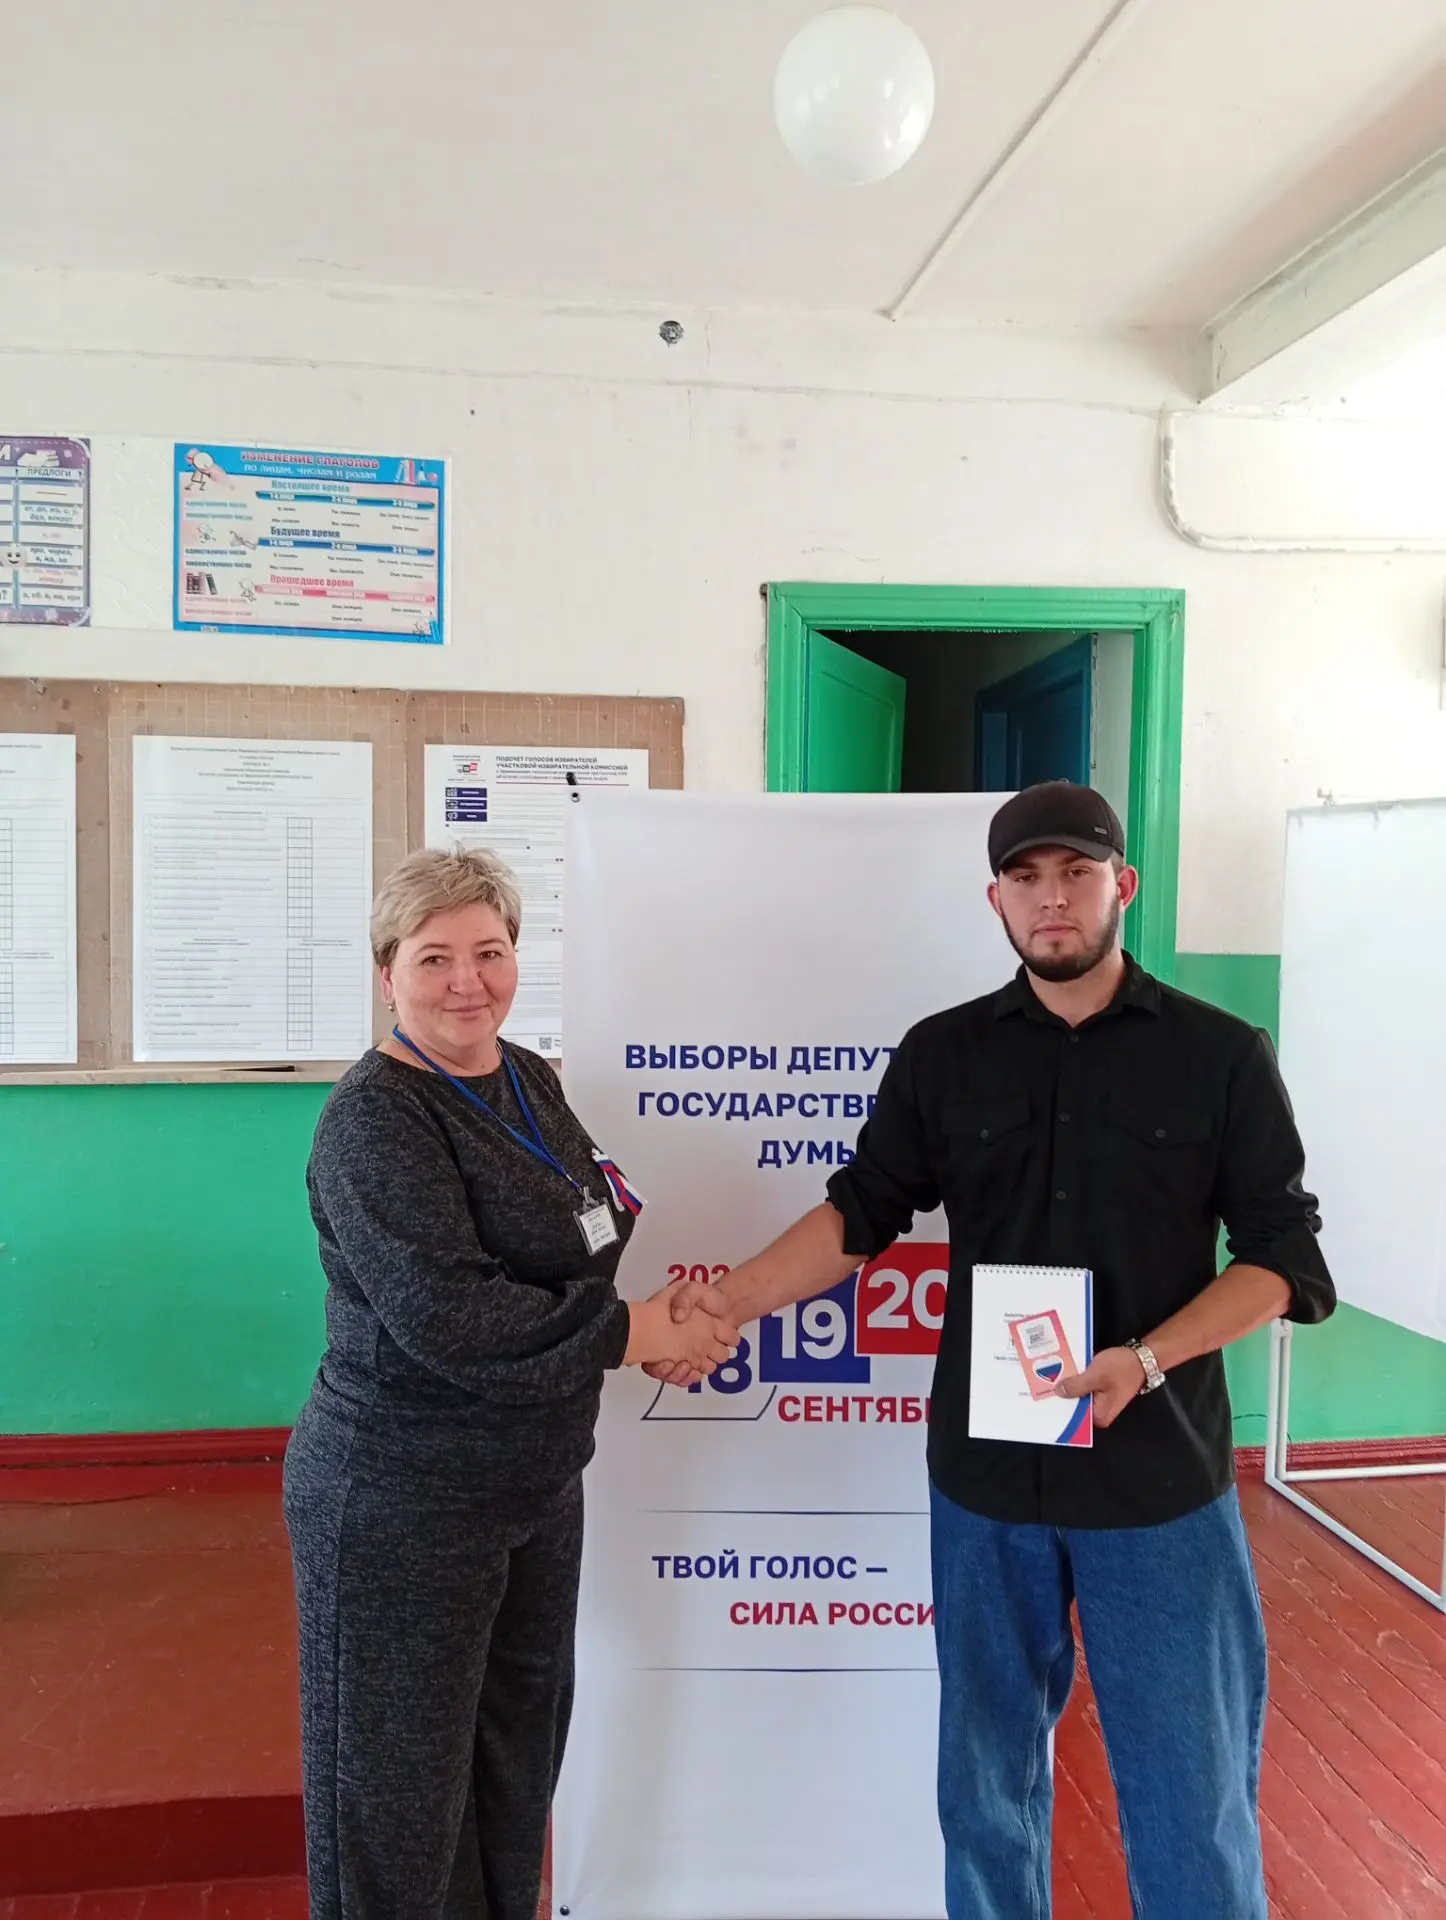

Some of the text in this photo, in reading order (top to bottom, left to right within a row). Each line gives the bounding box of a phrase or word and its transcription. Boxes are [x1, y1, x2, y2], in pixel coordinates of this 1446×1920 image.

[241, 452, 379, 469] ИЗМЕНЕНИЕ ГЛАГОЛОВ
[27, 468, 71, 477] ПРЕДЛОГИ
[271, 480, 320, 490] Настоящее
[270, 526, 340, 538] Будущее время
[270, 575, 355, 588] Прошедшее время
[625, 1045, 776, 1070] ВЫБОРЫ
[866, 1268, 949, 1330] 20
[771, 1299, 847, 1360] 19
[652, 1549, 739, 1579] ТВОЙ
[750, 1555, 857, 1579] ГОЛОС
[730, 1602, 818, 1625] СИЛА
